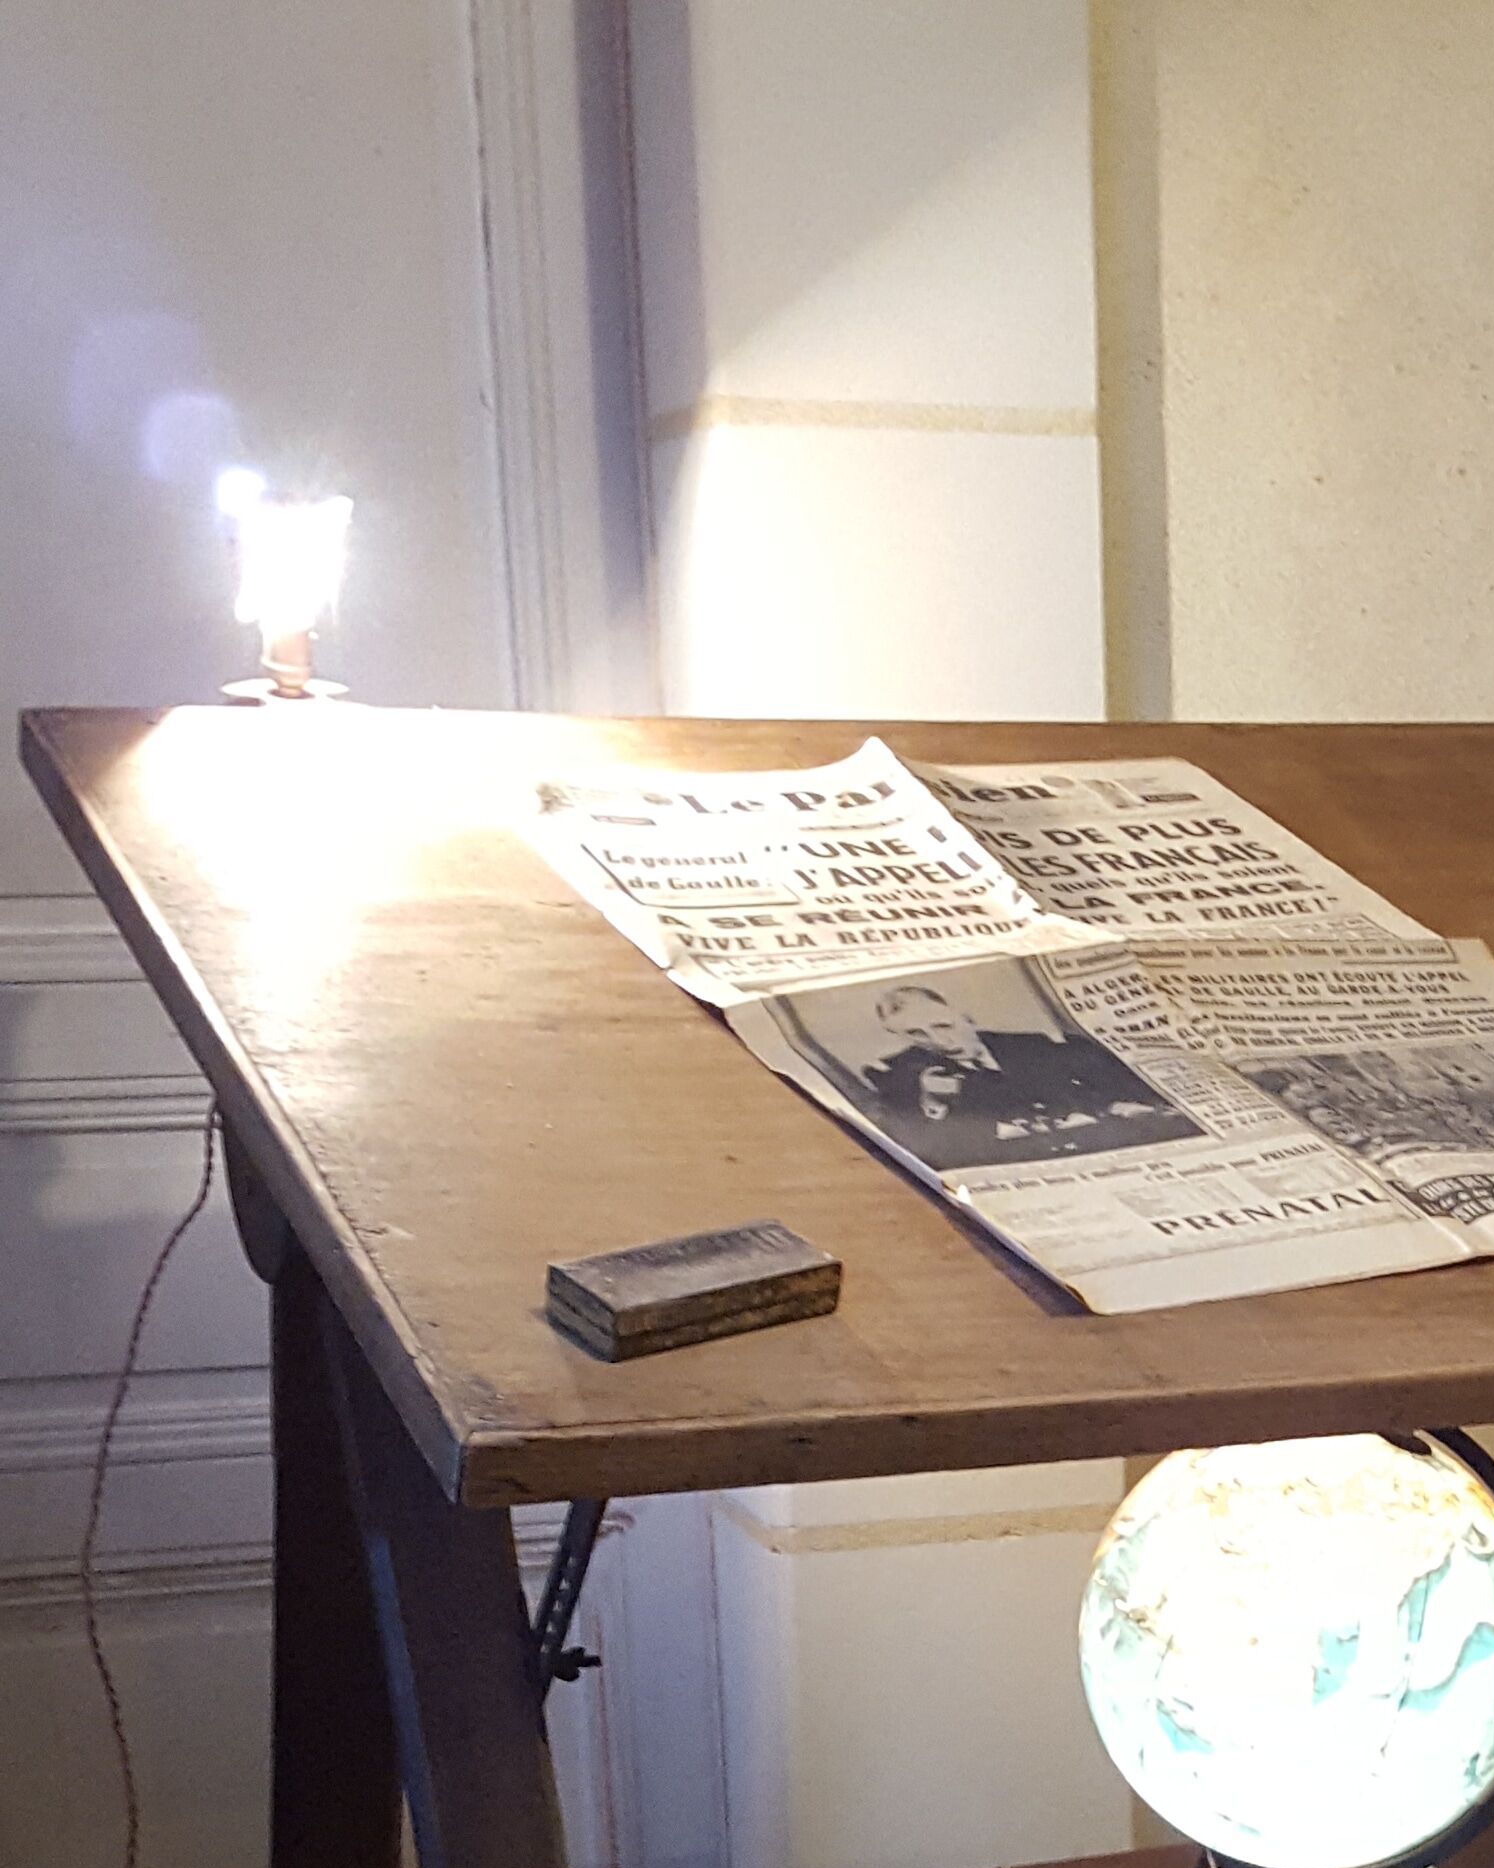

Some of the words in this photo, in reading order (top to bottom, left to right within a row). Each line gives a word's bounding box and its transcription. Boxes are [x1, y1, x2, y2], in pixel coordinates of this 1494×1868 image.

[1041, 827, 1115, 845] DE
[1118, 818, 1241, 841] PLUS
[1072, 842, 1279, 873] FRANÇAIS
[1218, 864, 1301, 879] soient
[707, 914, 783, 929] SE
[1049, 896, 1117, 910] LA
[675, 932, 757, 951] VIVE
[774, 932, 818, 948] LA
[1144, 911, 1183, 924] LA
[1187, 973, 1290, 985] MILITAIRES
[1293, 971, 1329, 983] ONT
[1070, 998, 1097, 1013] DU
[1150, 1188, 1392, 1235] PRENATAL
